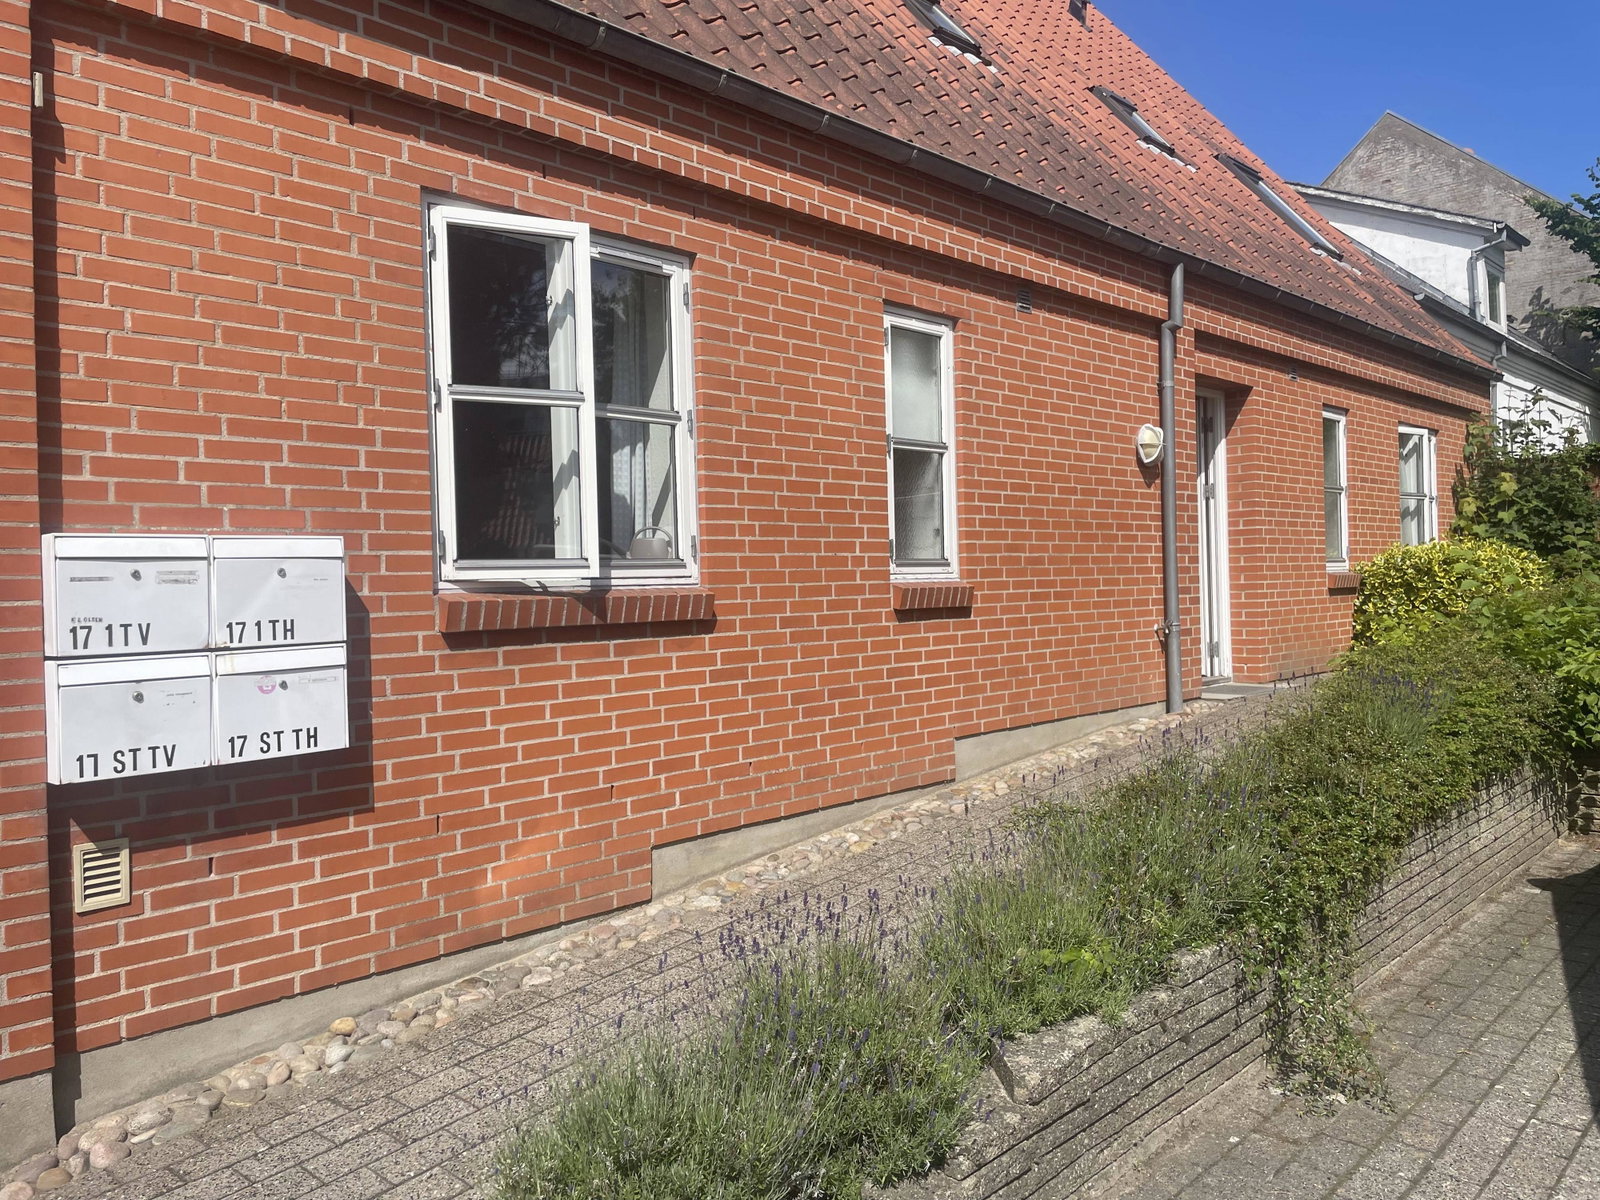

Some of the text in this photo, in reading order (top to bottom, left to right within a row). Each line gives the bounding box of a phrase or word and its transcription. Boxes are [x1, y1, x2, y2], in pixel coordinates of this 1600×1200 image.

[70, 626, 92, 650] 17
[226, 621, 247, 643] 17
[228, 726, 318, 758] 17 ST TH
[113, 748, 141, 774] ST
[147, 744, 176, 769] TV
